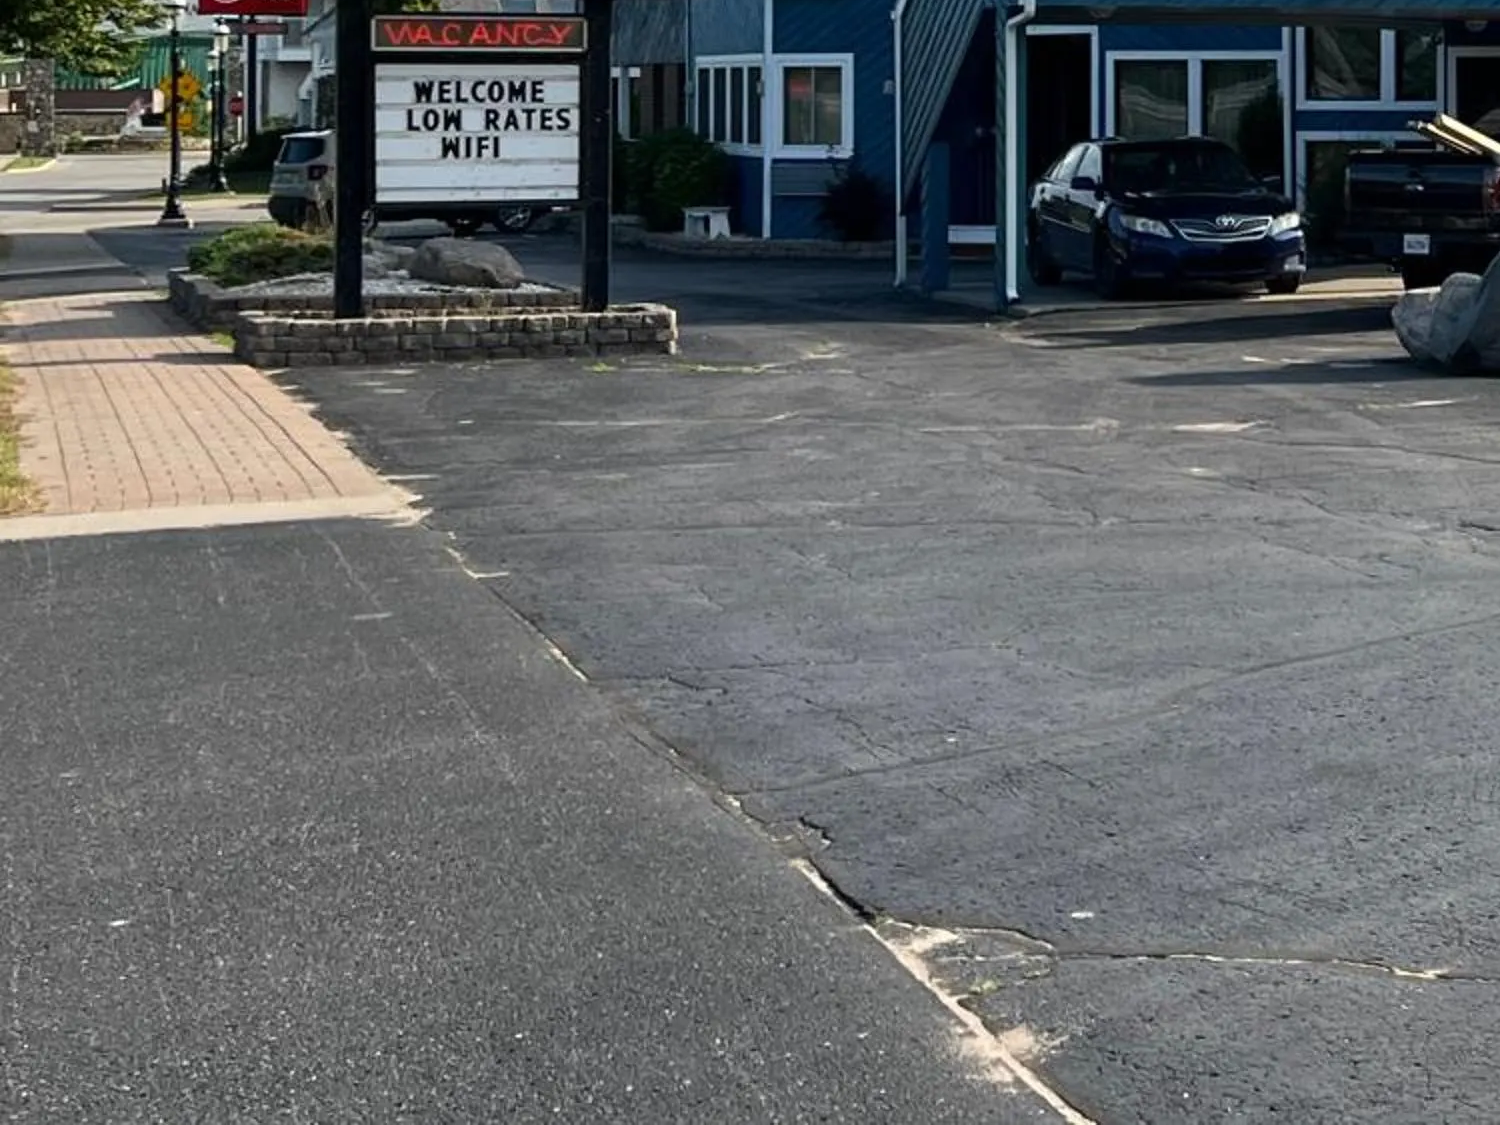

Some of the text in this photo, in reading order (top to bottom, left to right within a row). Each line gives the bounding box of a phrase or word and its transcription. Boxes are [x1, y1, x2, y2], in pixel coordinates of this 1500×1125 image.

[384, 23, 573, 45] VACANCY
[413, 81, 545, 103] WELCOME
[406, 109, 571, 132] LOW RATES
[441, 137, 500, 159] WIFI
